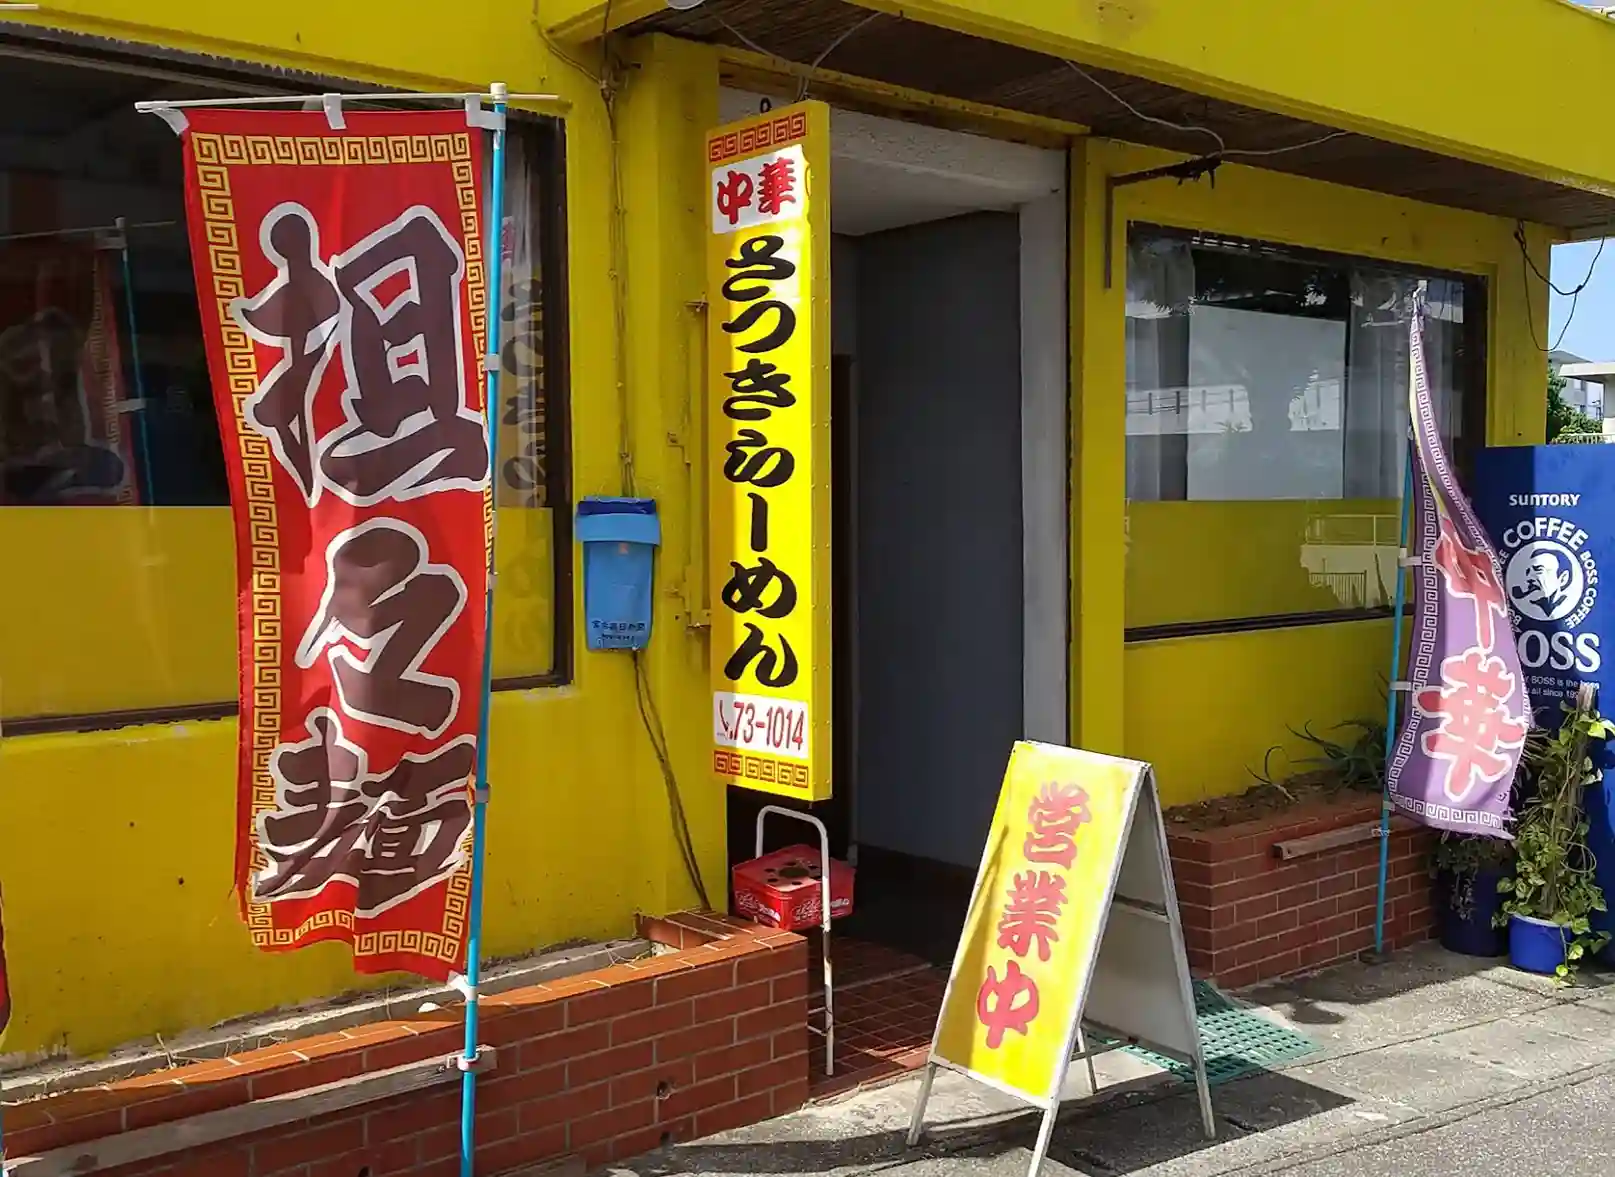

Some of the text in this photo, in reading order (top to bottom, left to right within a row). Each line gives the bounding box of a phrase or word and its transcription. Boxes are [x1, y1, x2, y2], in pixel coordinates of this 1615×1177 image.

[716, 157, 797, 225] 中華
[721, 234, 799, 688] さつきらーめん
[228, 201, 492, 919] 担々麺
[1503, 517, 1589, 551] COFFEE
[1565, 550, 1599, 629] BOSS COFFEE
[1516, 629, 1601, 673] OSS
[733, 701, 804, 751] 73-1014
[976, 780, 1093, 1050] 営業中
